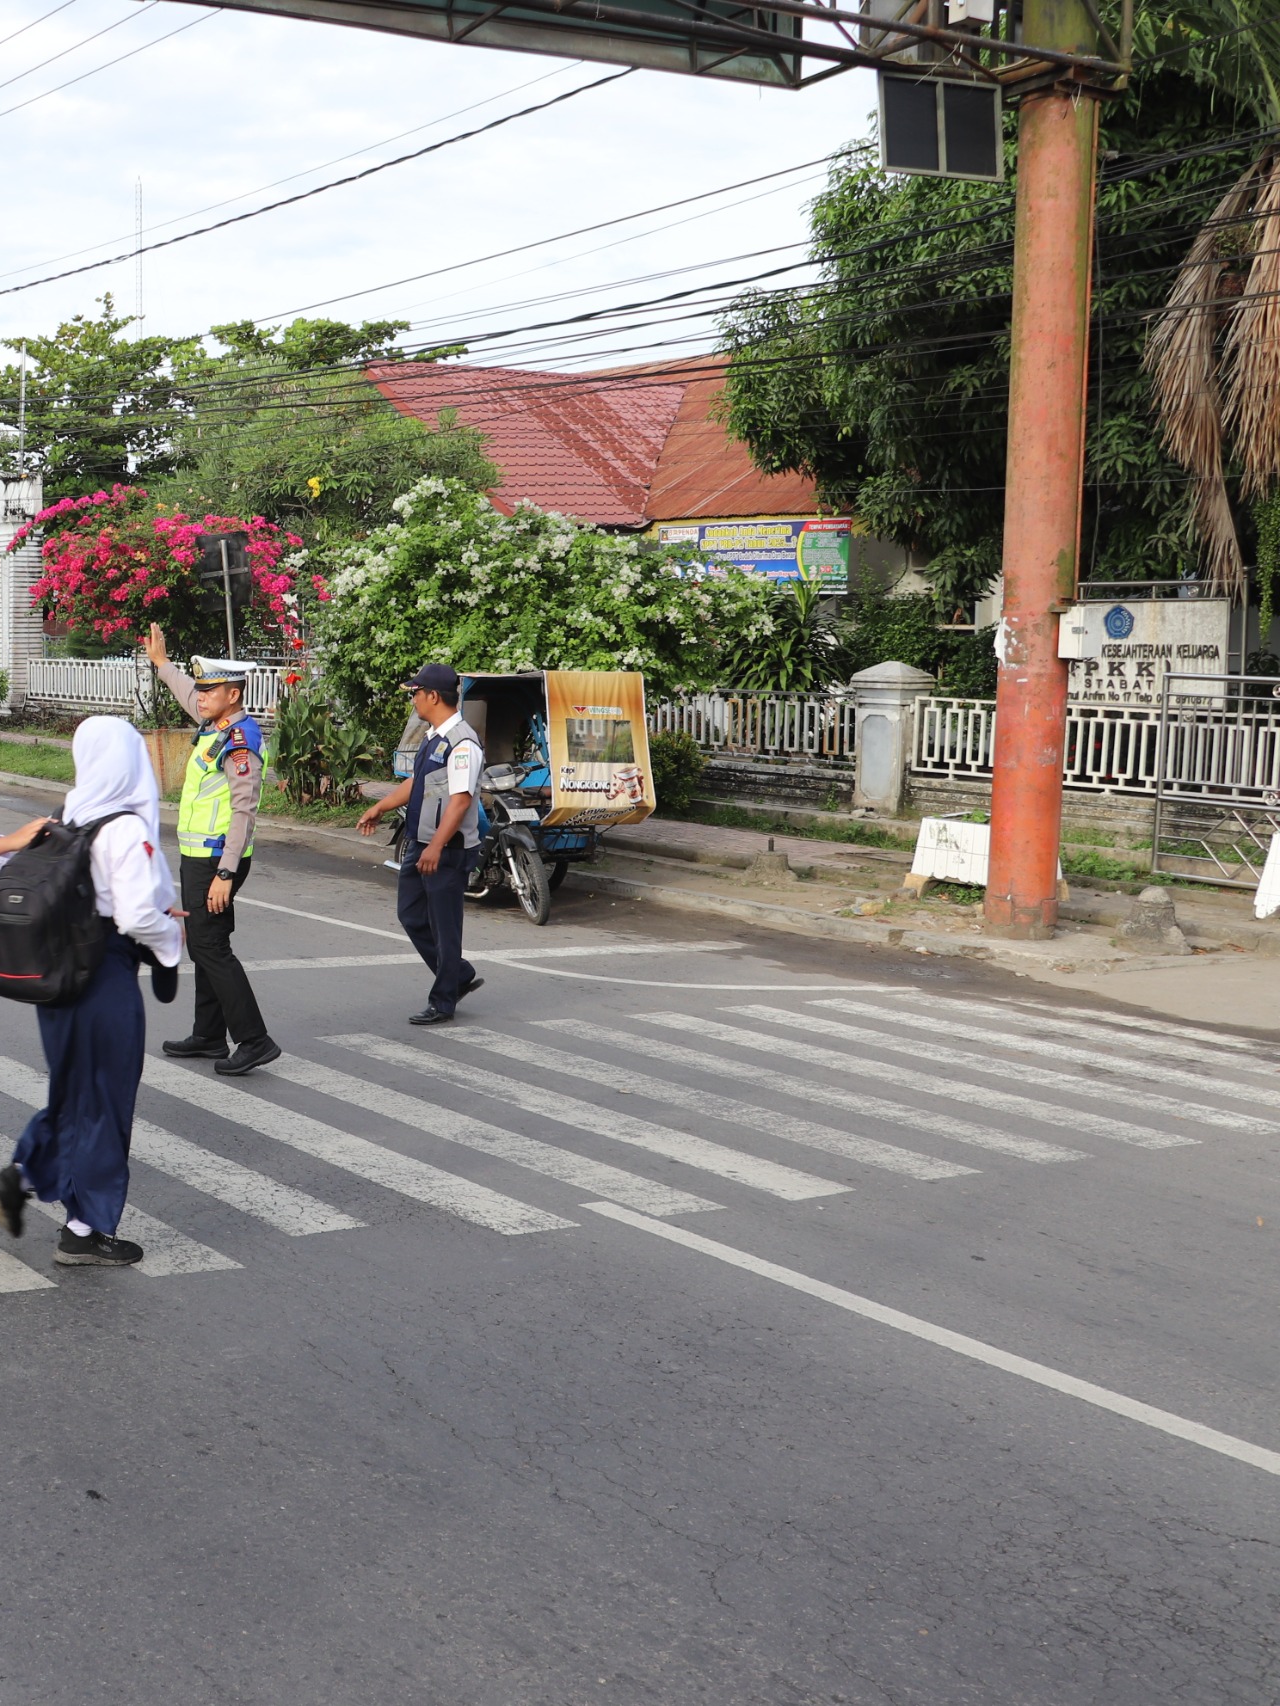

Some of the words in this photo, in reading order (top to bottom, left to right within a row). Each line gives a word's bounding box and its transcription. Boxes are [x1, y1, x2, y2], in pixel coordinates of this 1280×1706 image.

[1101, 644, 1173, 659] KESEJAHTERAAN
[1176, 644, 1219, 660] KELUARGA
[1084, 679, 1154, 690] STABAT
[1108, 691, 1120, 701] No
[1122, 692, 1132, 701] 17
[1135, 693, 1153, 704] Telp
